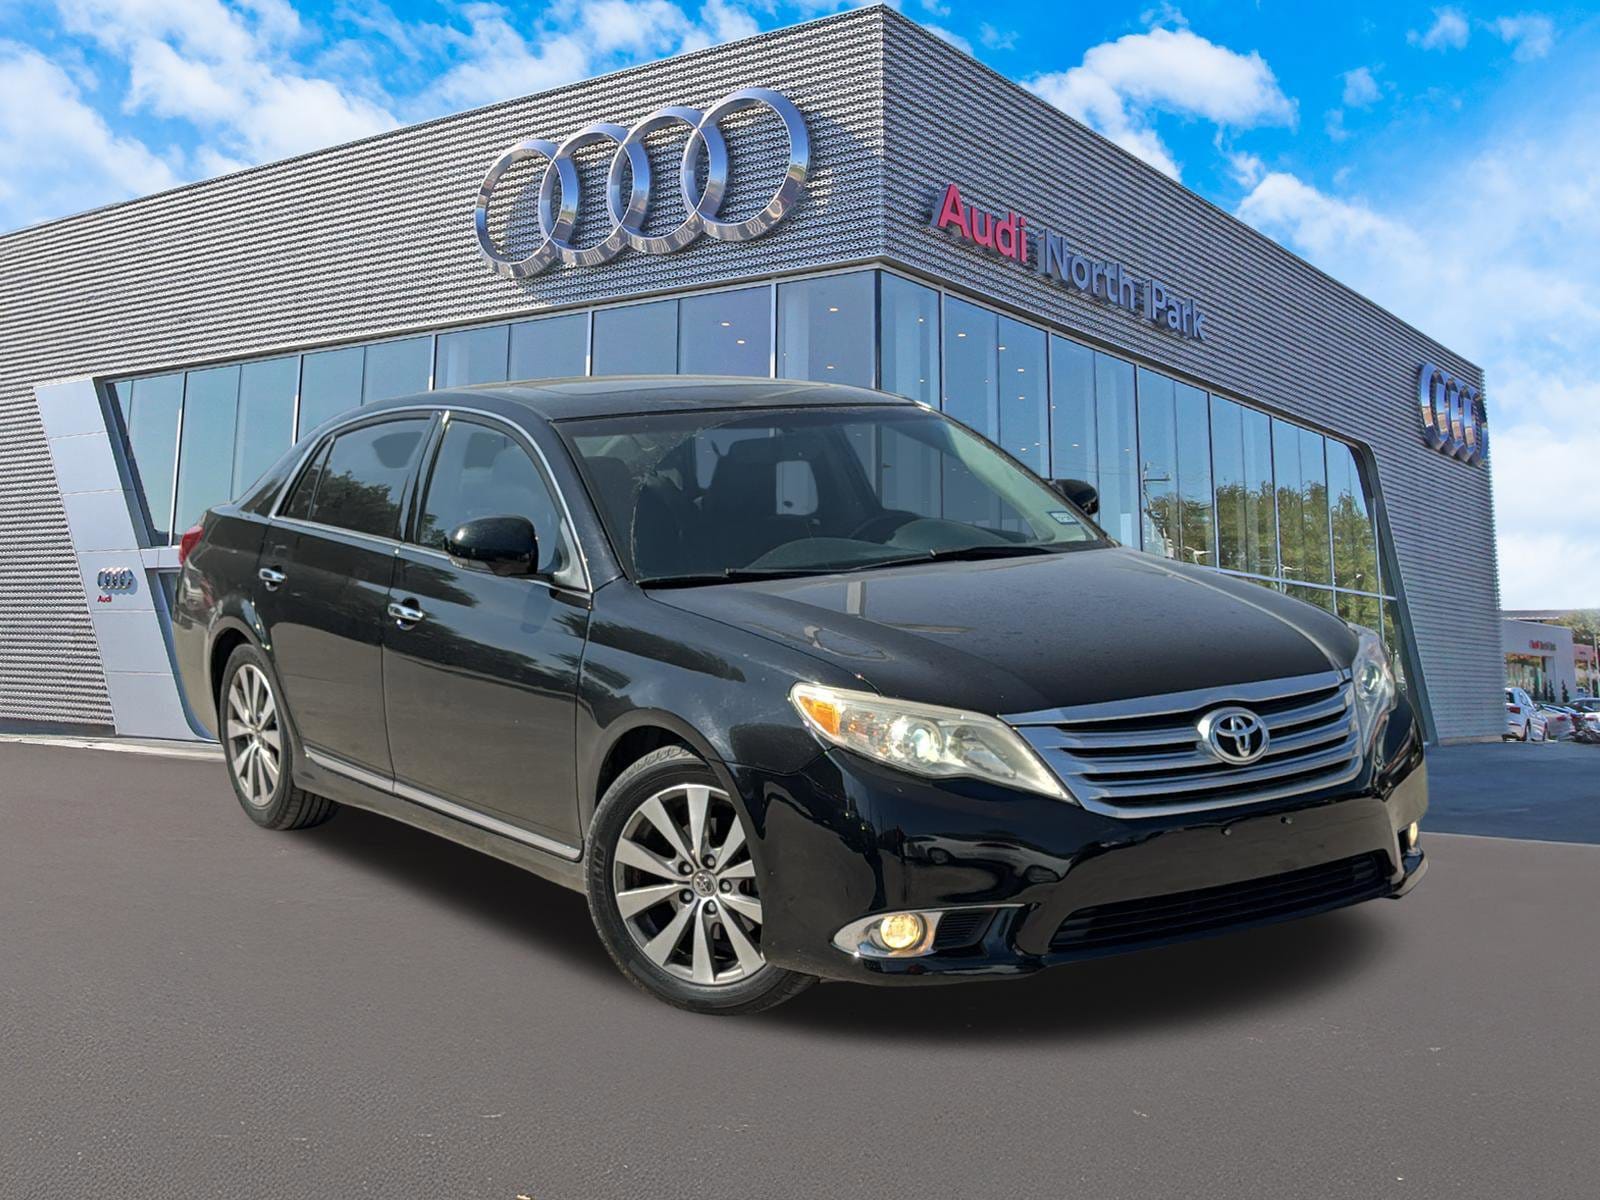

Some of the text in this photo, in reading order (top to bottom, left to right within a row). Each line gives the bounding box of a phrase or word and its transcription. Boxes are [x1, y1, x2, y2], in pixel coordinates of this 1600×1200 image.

[934, 183, 1208, 340] Audi North Park
